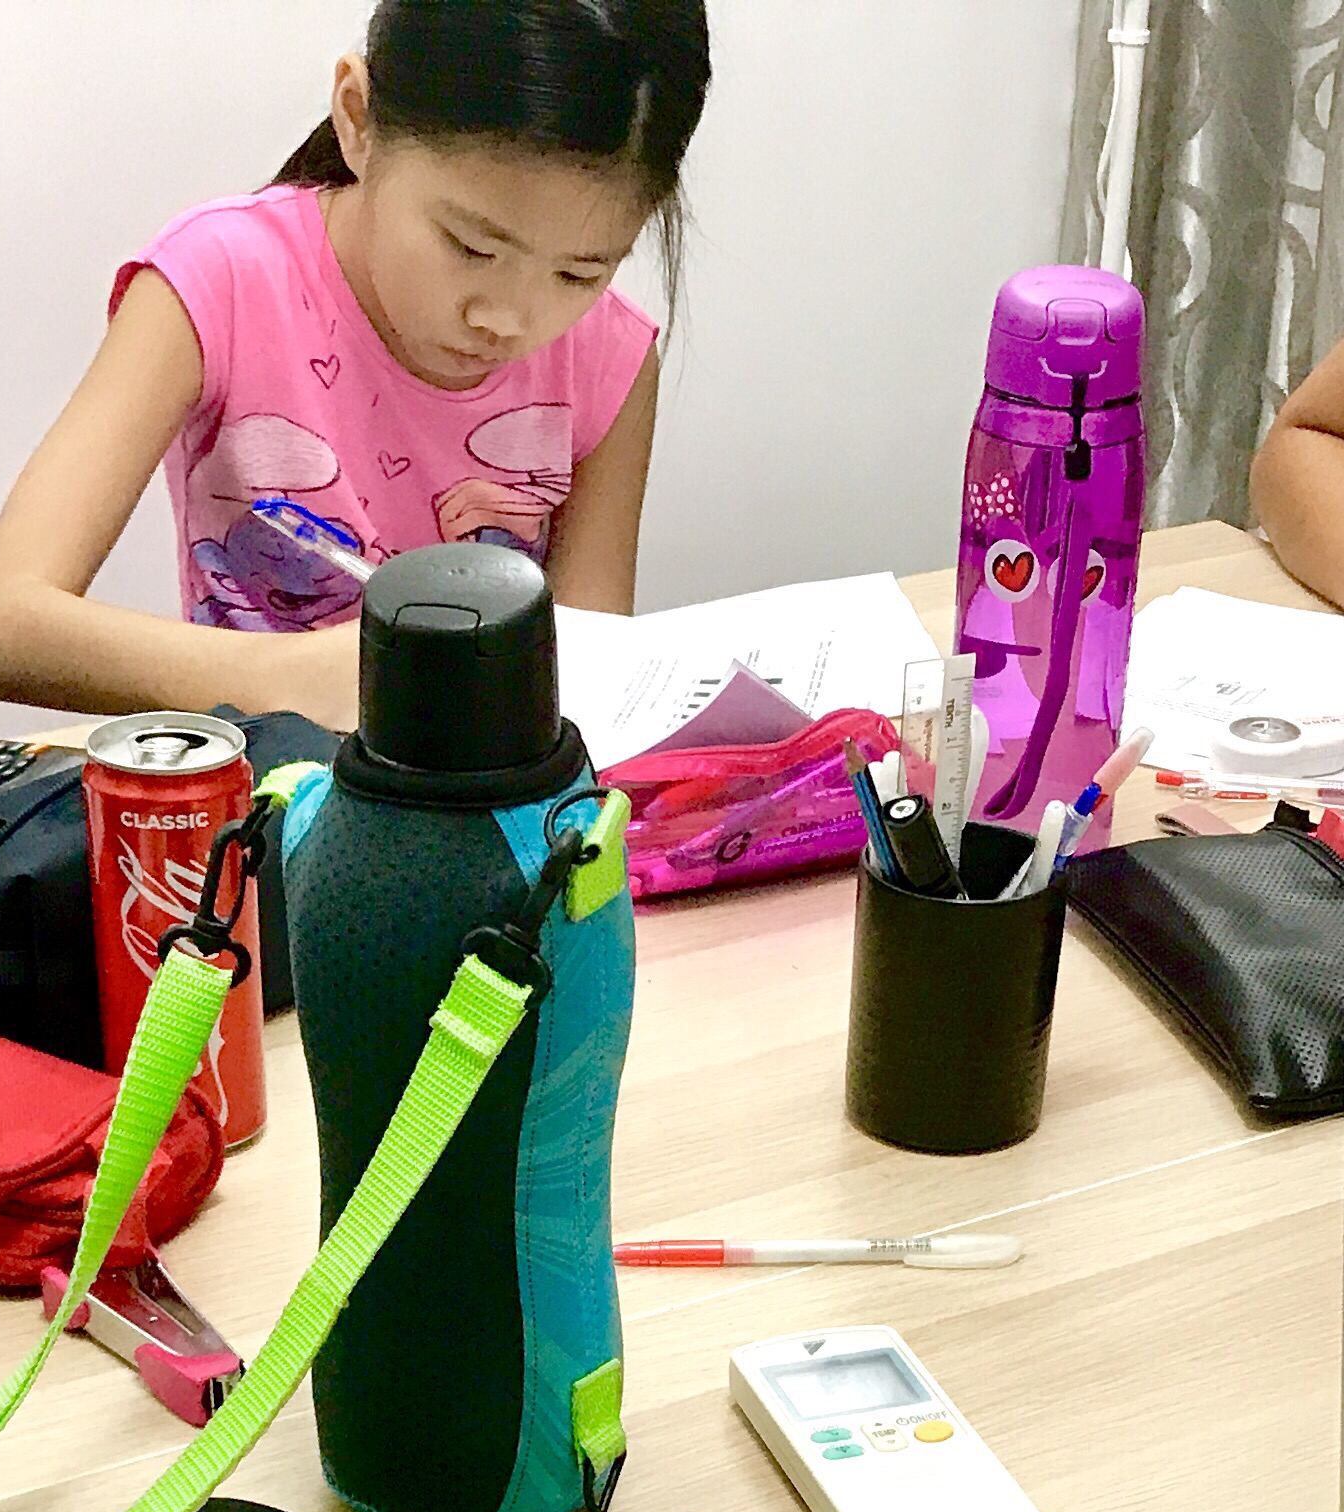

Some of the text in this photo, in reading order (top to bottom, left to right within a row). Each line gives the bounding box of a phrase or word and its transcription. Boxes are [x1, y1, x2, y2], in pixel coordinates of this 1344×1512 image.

[120, 811, 210, 829] CLASSIC
[909, 1410, 948, 1423] ON/OFF
[872, 1427, 896, 1439] TEMP
